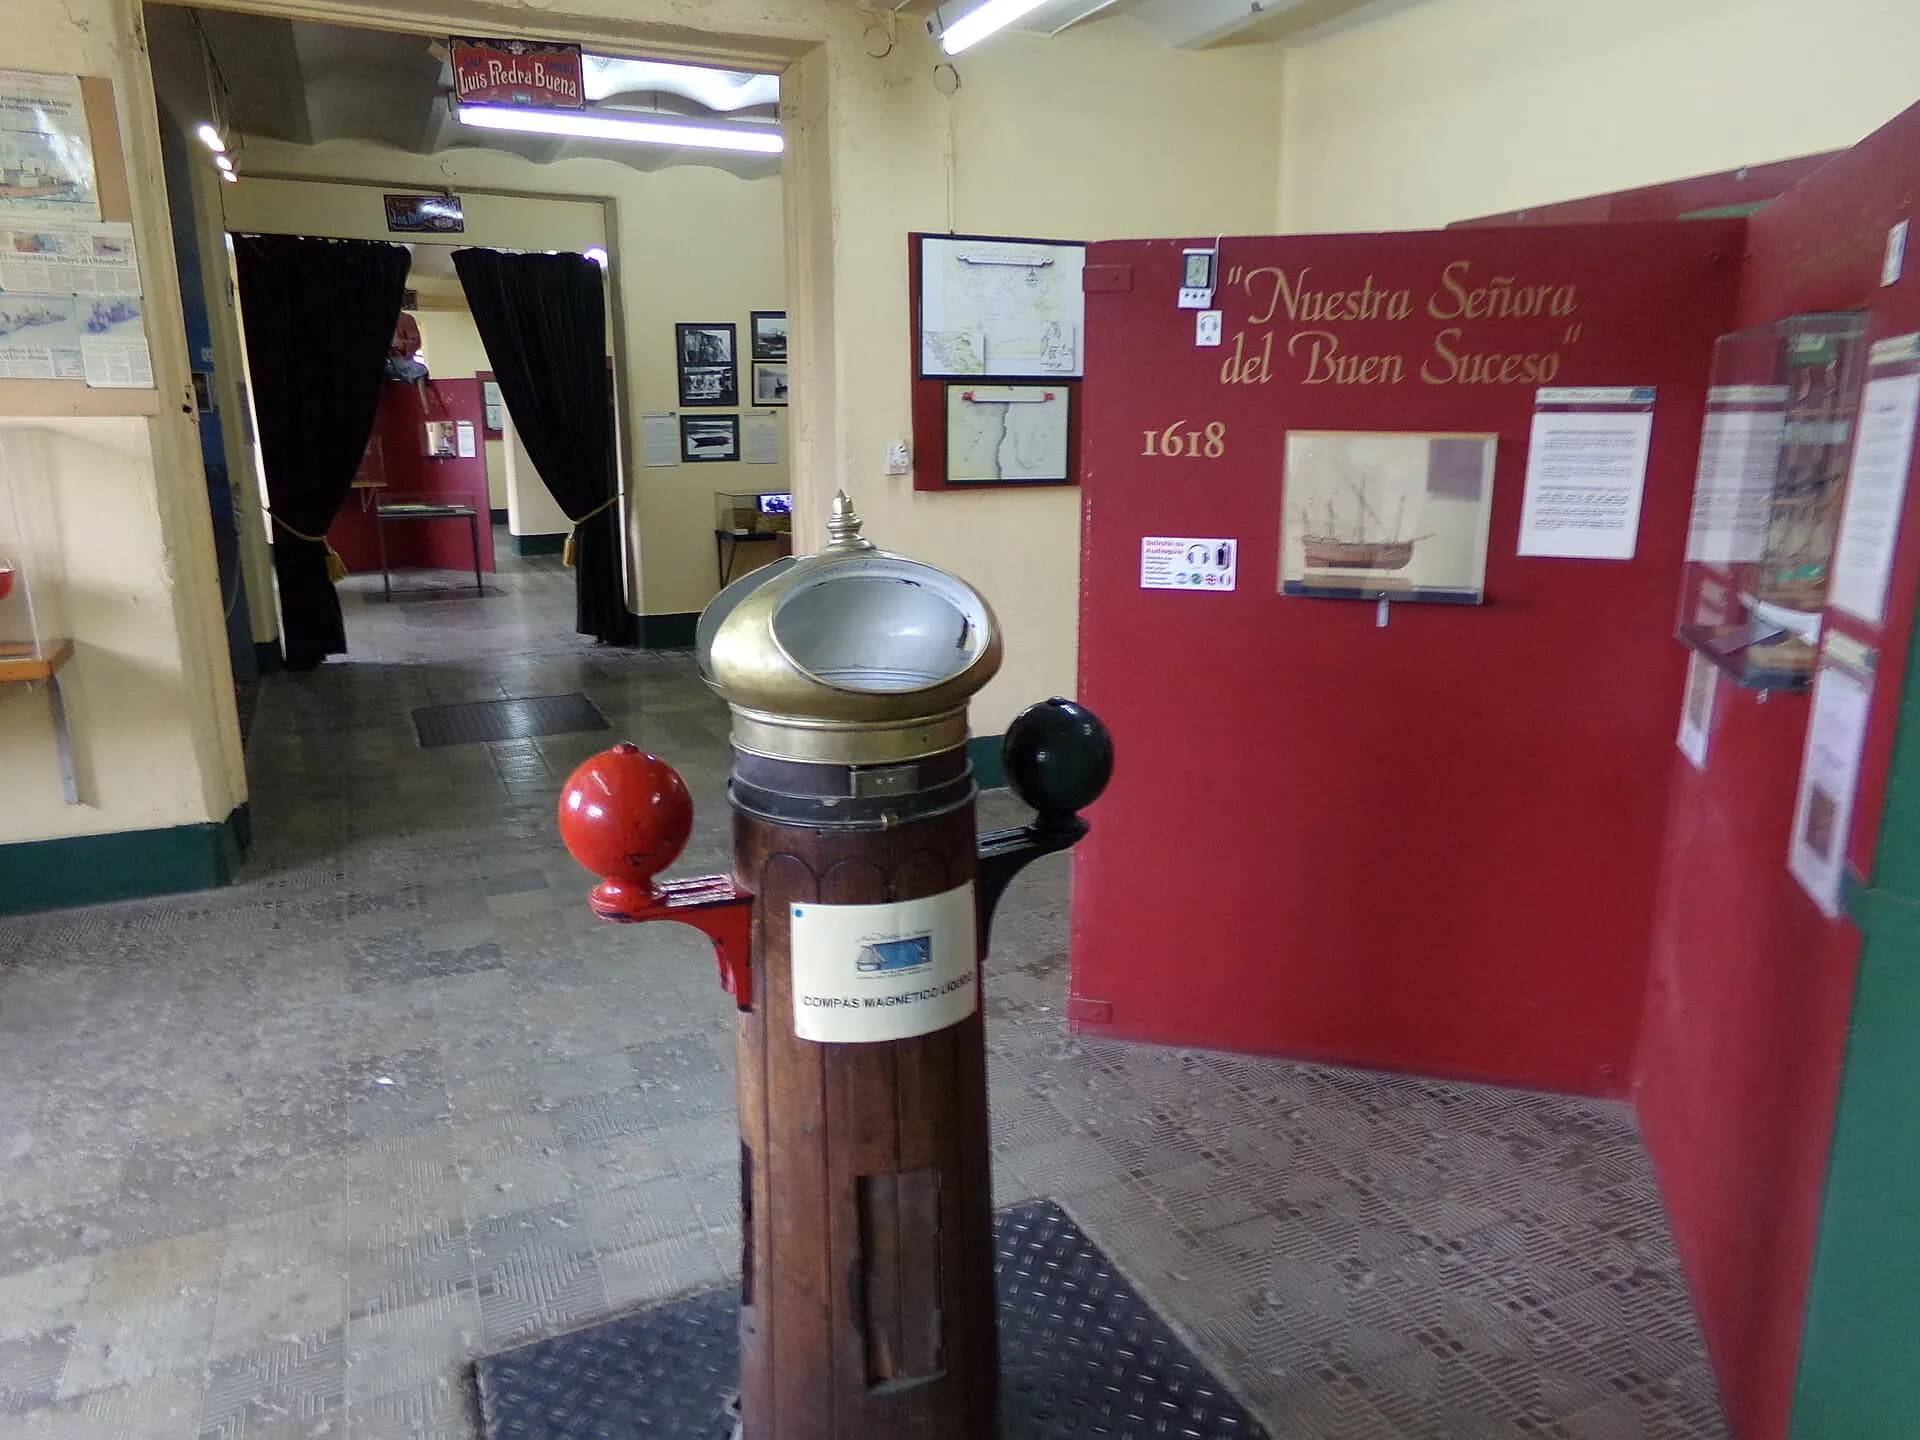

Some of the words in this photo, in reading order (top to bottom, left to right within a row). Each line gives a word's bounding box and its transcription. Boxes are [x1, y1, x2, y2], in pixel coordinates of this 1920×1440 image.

[458, 66, 488, 95] Luis
[488, 59, 532, 86] Piedra
[534, 62, 577, 98] Buena
[1227, 265, 1415, 325] "Nuestra
[1428, 260, 1578, 320] Señora
[1220, 331, 1274, 385] del
[1287, 330, 1407, 385] Buen
[1140, 419, 1226, 459] 1618
[803, 994, 860, 1009] COMPÁS
